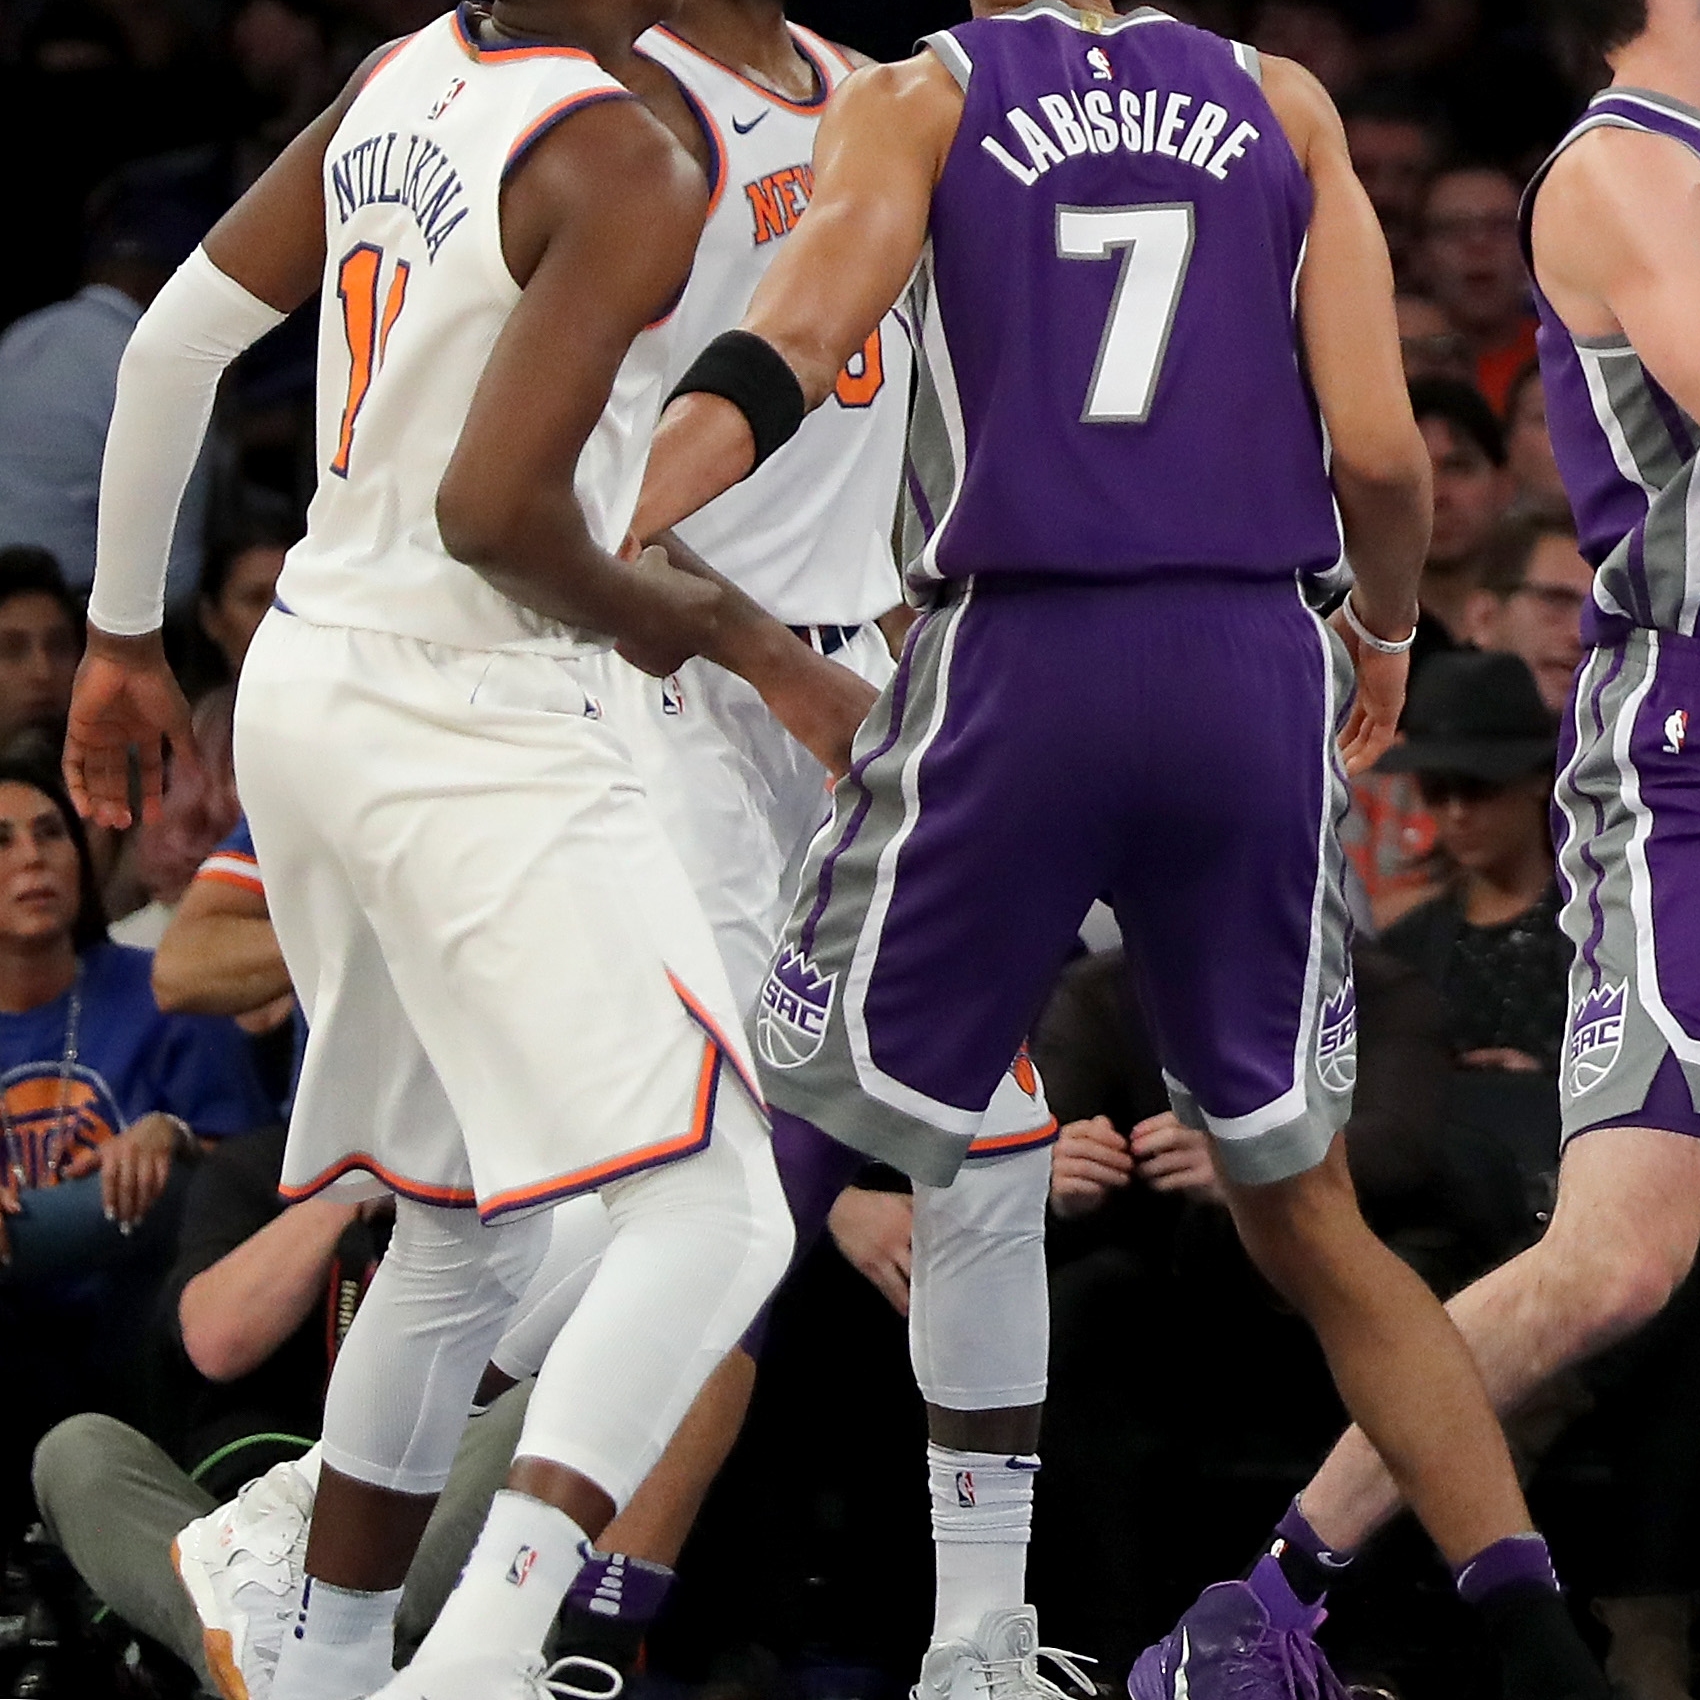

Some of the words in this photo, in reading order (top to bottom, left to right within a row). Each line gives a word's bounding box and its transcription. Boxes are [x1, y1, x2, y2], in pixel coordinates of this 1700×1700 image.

[980, 87, 1260, 188] LABISSIERE
[332, 132, 470, 267] NTILIKINA
[1055, 201, 1195, 424] 7
[763, 978, 826, 1035] SAC
[1571, 1019, 1621, 1062] SAC
